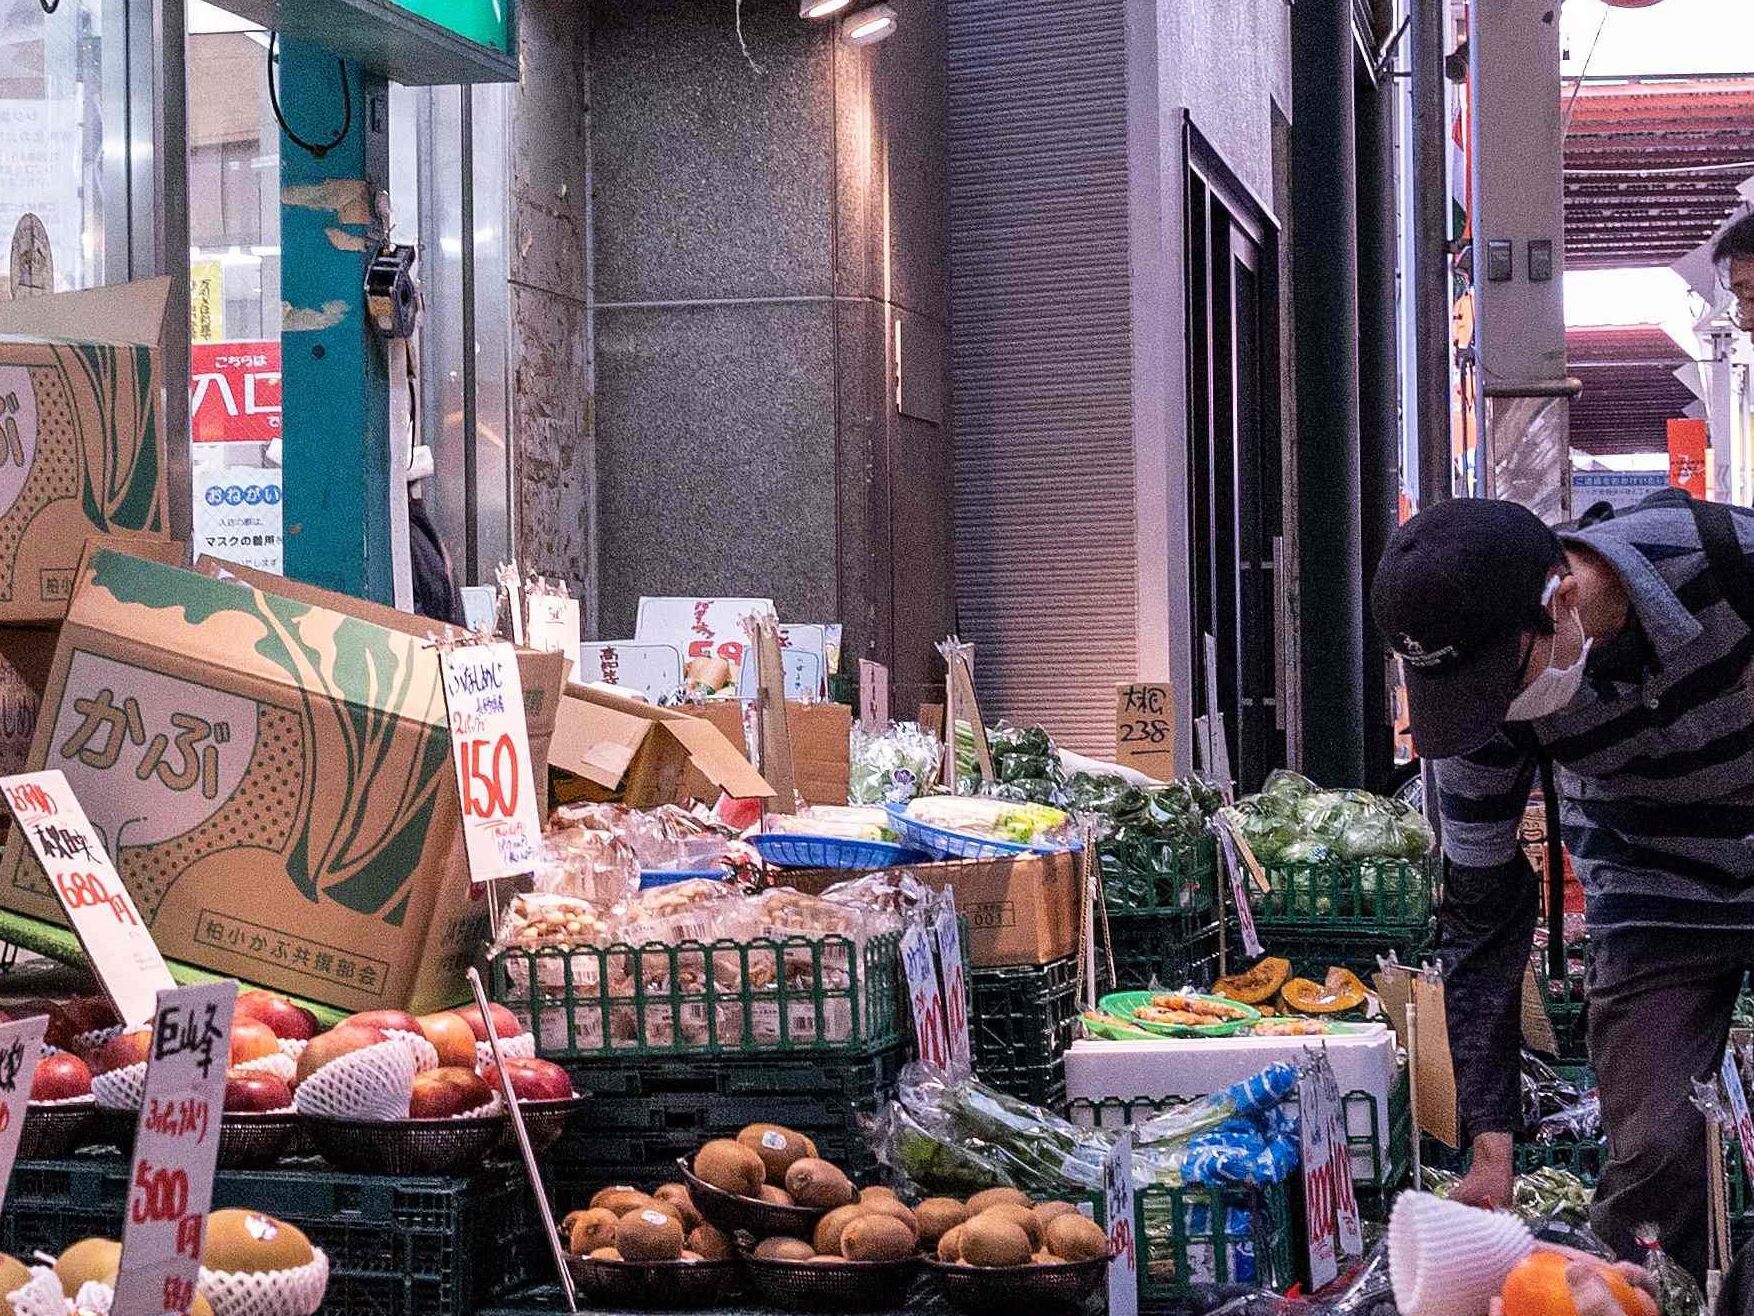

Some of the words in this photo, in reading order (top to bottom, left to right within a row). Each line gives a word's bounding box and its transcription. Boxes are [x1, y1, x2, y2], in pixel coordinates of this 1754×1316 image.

[214, 354, 268, 369] こちらは
[59, 688, 234, 801] かぶ
[1119, 719, 1170, 744] 238
[459, 732, 519, 819] 150
